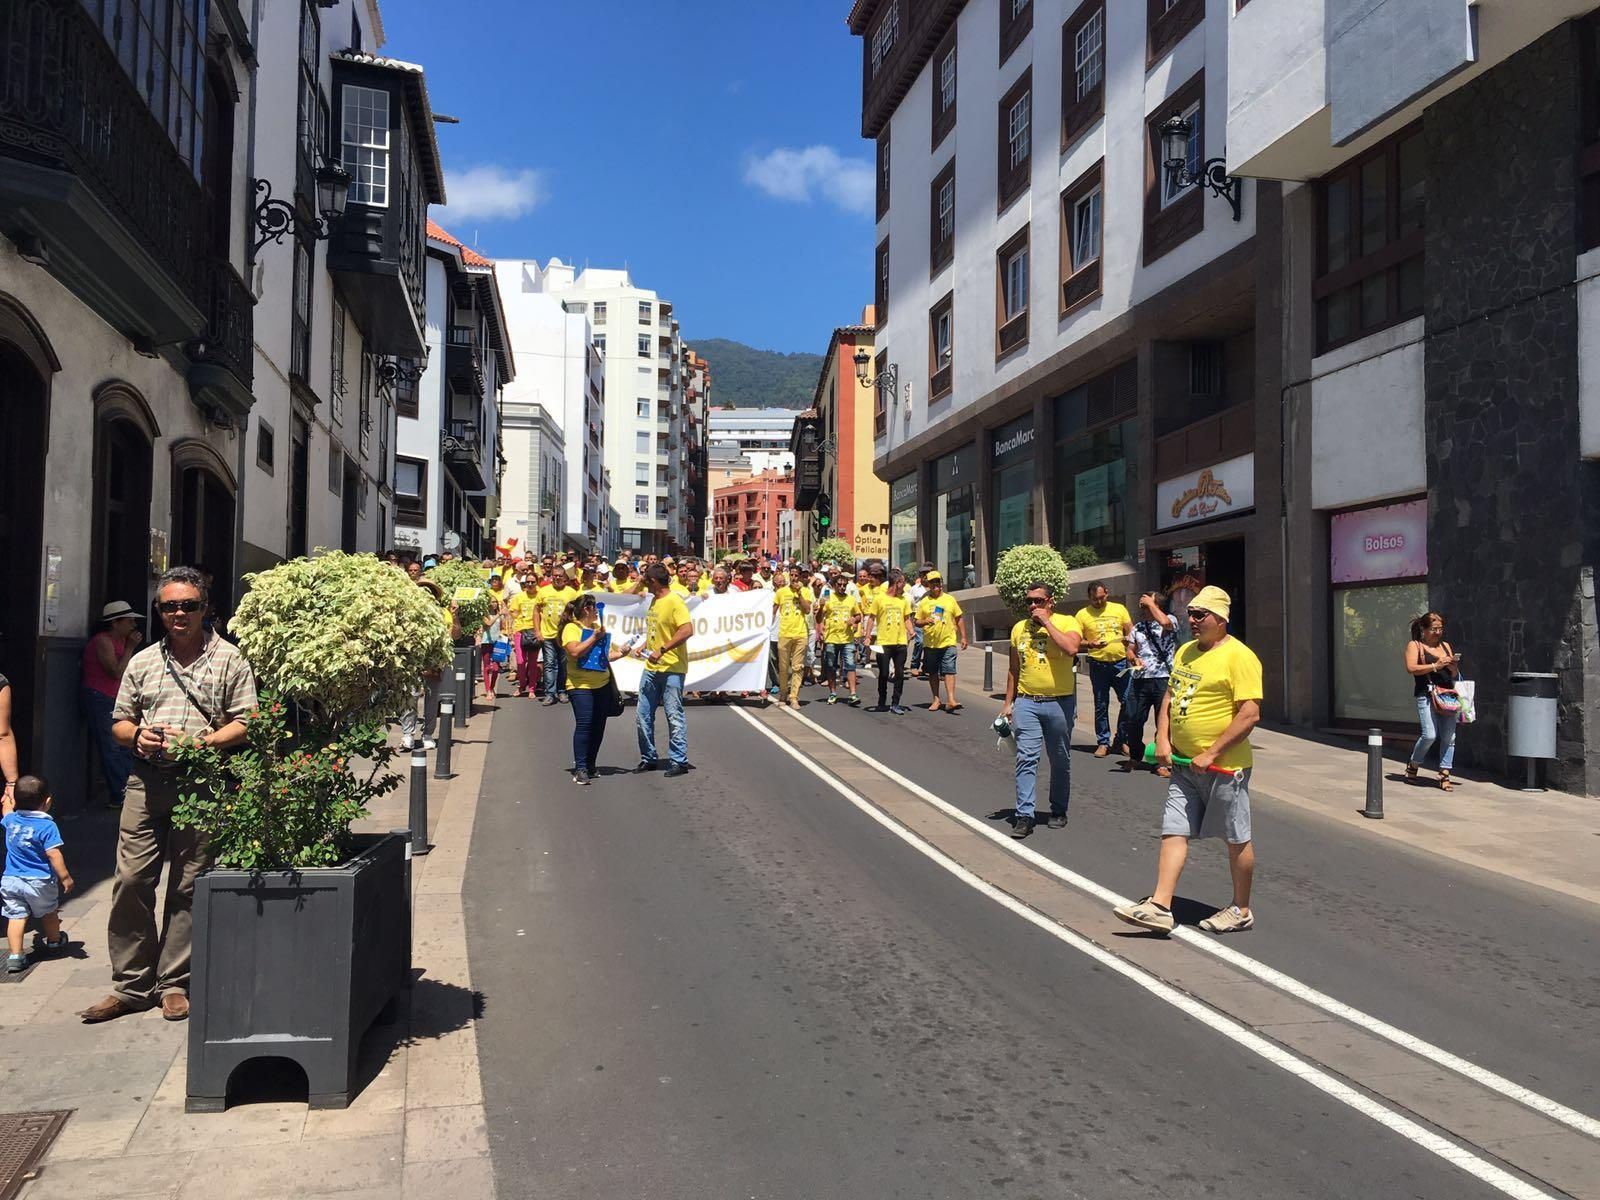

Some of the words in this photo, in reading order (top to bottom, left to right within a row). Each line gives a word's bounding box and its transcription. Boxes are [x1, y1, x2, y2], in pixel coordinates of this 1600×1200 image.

[995, 428, 1035, 457] BancaMarc
[855, 545, 890, 554] Felician
[1365, 535, 1404, 552] Bolsos
[713, 611, 766, 634] JUSTO
